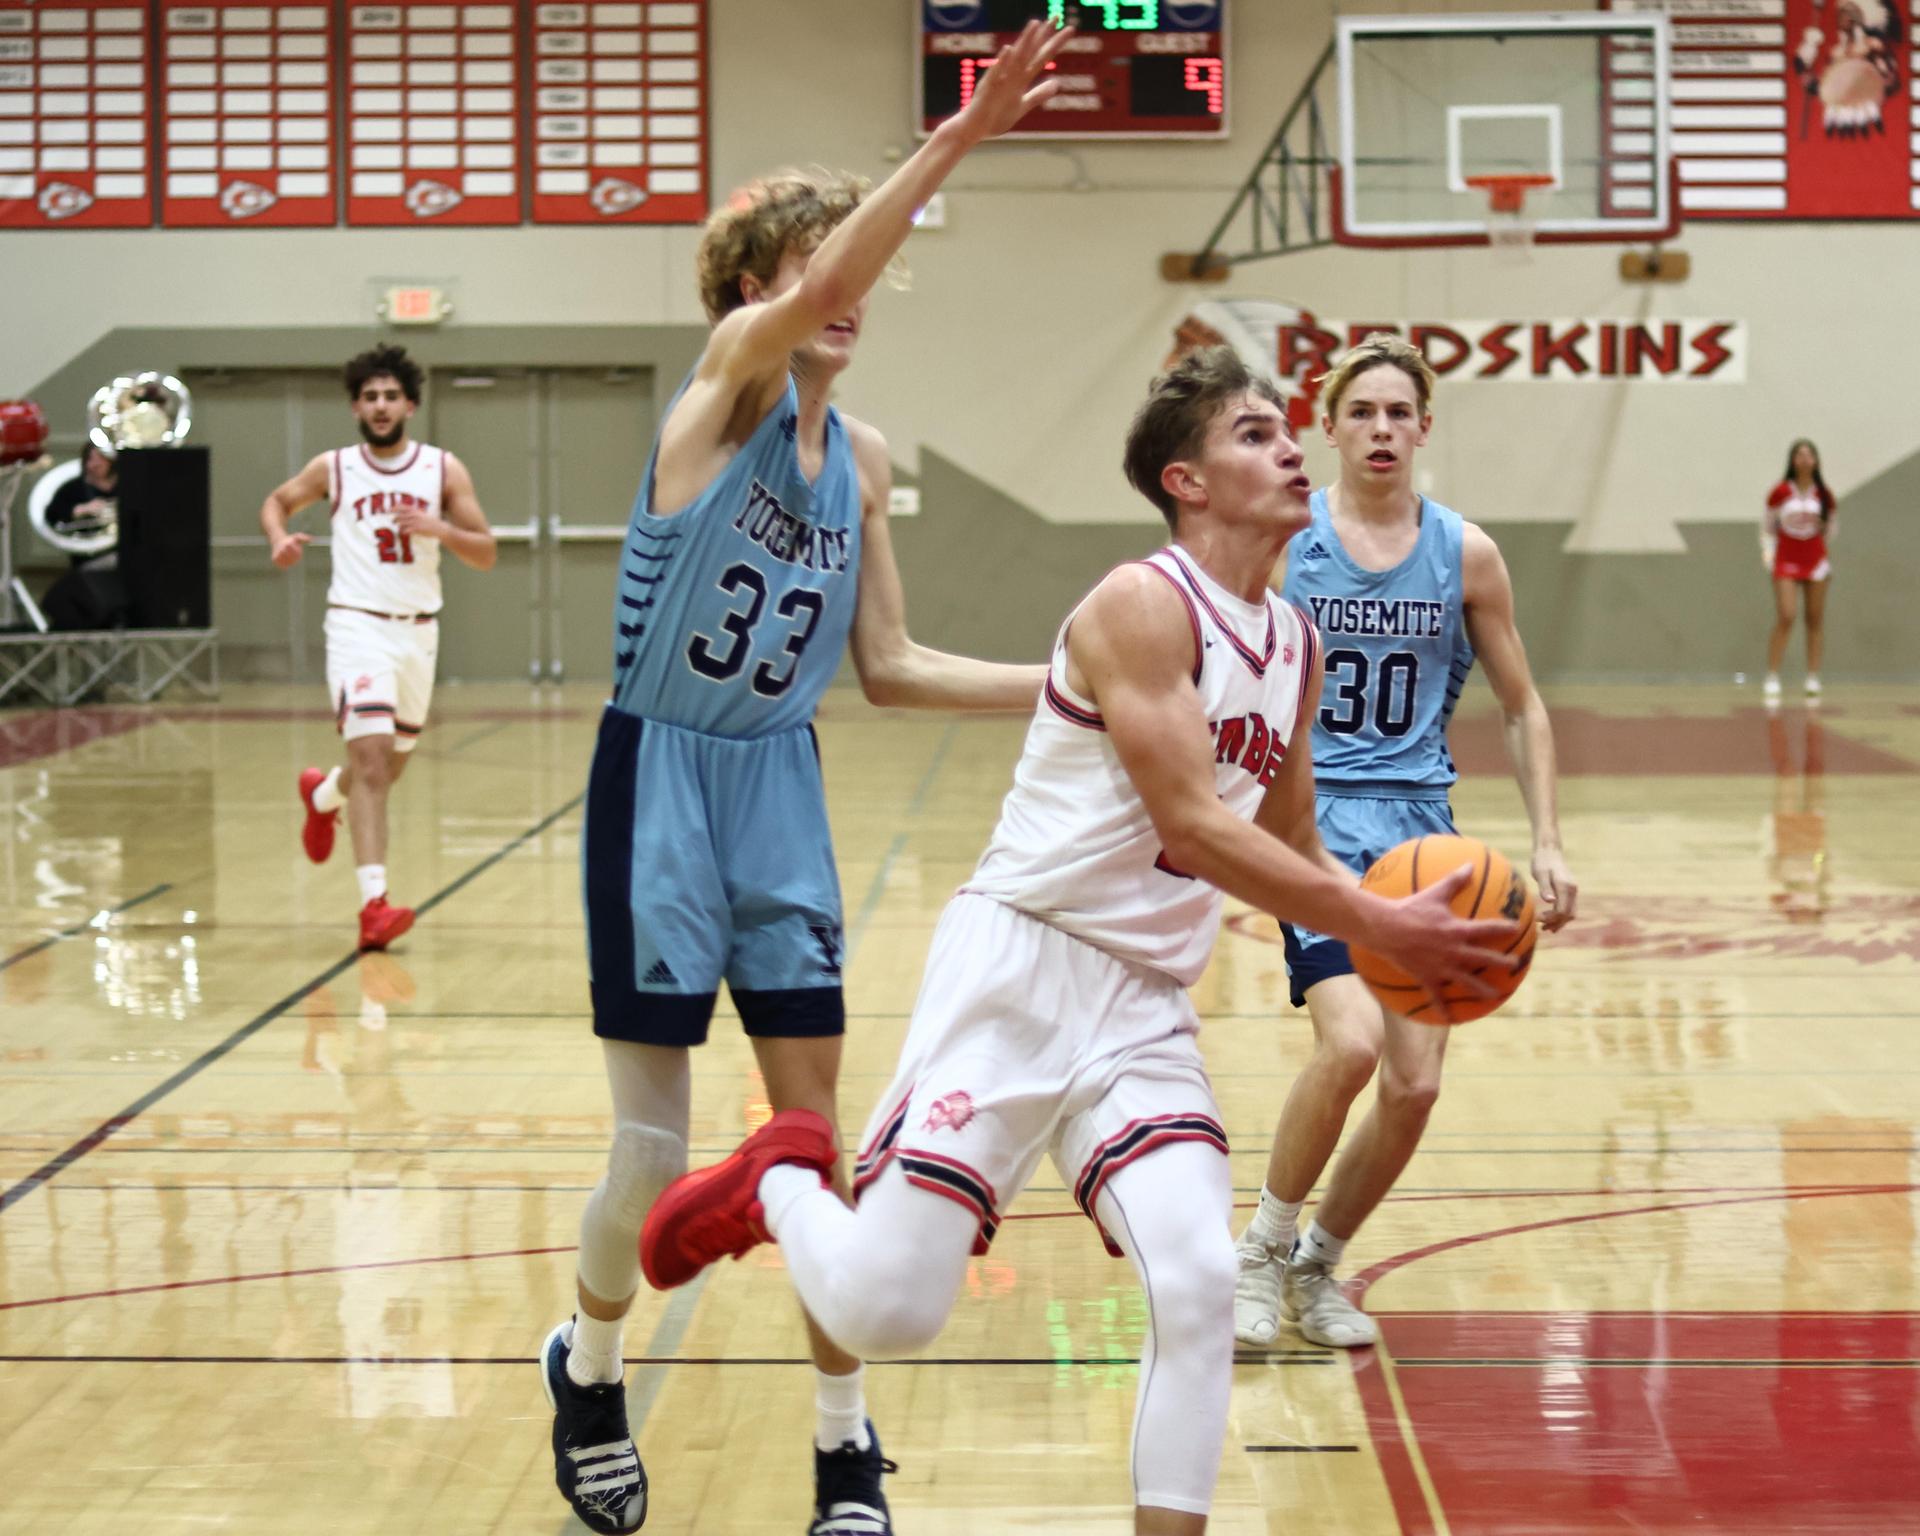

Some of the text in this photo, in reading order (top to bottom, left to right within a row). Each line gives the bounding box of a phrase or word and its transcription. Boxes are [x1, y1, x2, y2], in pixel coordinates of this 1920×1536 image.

[1184, 57, 1223, 114] 9
[374, 526, 415, 564] 21
[686, 560, 826, 699] 33
[1309, 596, 1444, 637] YOSEMITE
[1319, 648, 1419, 738] 30
